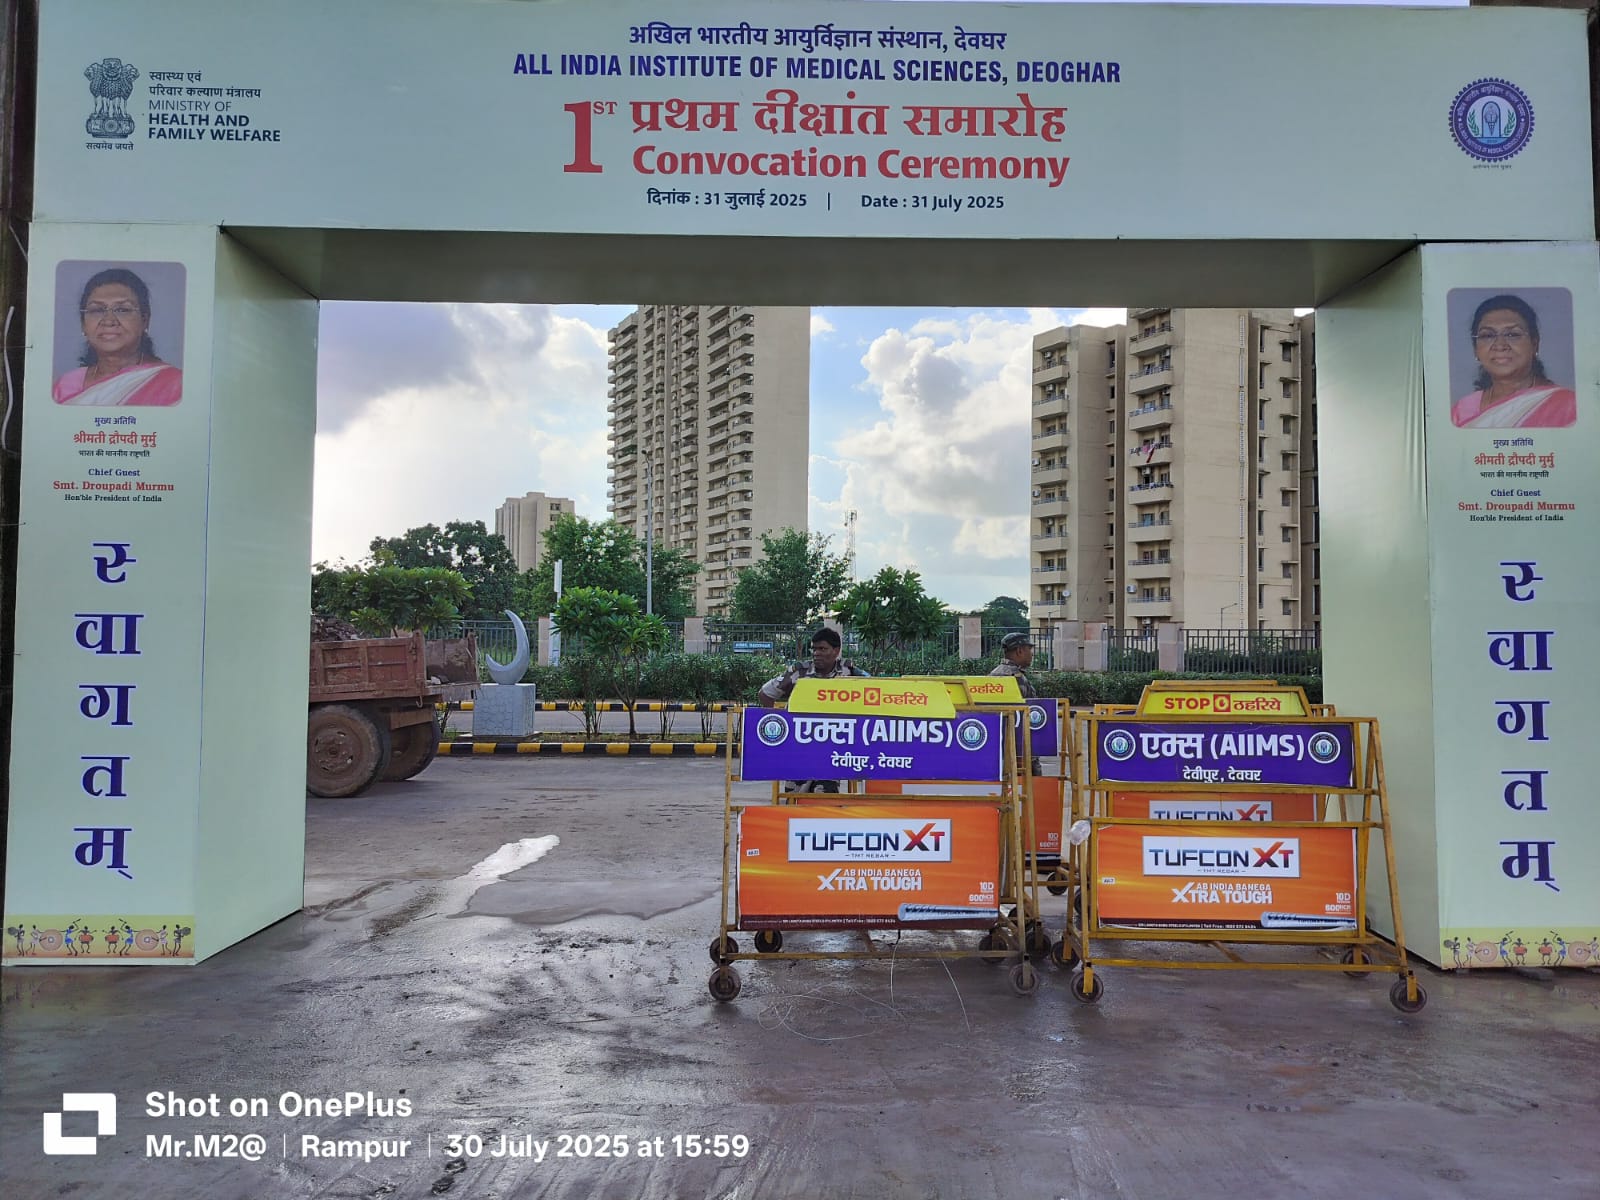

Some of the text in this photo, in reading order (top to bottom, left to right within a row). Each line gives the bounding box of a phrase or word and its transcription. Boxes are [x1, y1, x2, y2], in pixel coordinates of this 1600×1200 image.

[629, 21, 1007, 53] अखिल भारतीय आयुर्विज्ञान संस्थान, देवघर
[149, 70, 202, 83] स्वास्थ्य एवं
[513, 53, 1121, 86] ALL INDIA INSTITUTE OF MEDICAL SCIENCES, DEOGHAR
[149, 84, 261, 99] परिवार कल्याण मंत्रालय
[149, 100, 232, 112] MINISTRY OF
[149, 113, 250, 127] HEALTH AND
[629, 88, 1068, 143] प्रथम दीक्षांत समारोह
[149, 127, 281, 142] FAMILY WELFARE
[86, 142, 113, 150] सत्यमेव
[633, 145, 1070, 188] Convocation Ceremony
[647, 188, 691, 205] दिनांक
[704, 192, 720, 205] 31
[725, 189, 766, 210] जुलाई
[769, 193, 807, 207] 2025
[861, 195, 898, 208] Date
[911, 196, 927, 208] 31
[932, 195, 963, 212] July
[967, 196, 1005, 209] 2025
[74, 430, 106, 444] श्रीमती
[1474, 452, 1505, 465] श्रीमती
[88, 468, 140, 477] Chief Guest
[53, 480, 174, 492] Smt. Droupadi Murmu
[1490, 489, 1541, 497] Chief Guest
[64, 494, 92, 502] Hon'ble
[94, 494, 130, 502] President
[132, 494, 141, 502] of
[1458, 501, 1575, 512] Smt. Droupadi Murmu
[1470, 514, 1497, 522] Hon'ble
[969, 684, 1004, 695] ठहरिये
[817, 689, 929, 706] STOP ठहरिये
[1164, 698, 1281, 711] STOP ठहरिये
[793, 717, 856, 745] एम्स
[862, 719, 953, 748] (AIIMS)
[1139, 733, 1204, 760] एम्स
[1210, 733, 1304, 761] (AIIMS)
[831, 751, 913, 771] देवीपुर, देवघर
[1183, 766, 1262, 783] देवीपुर, देवघर
[817, 868, 922, 891] XTRA TOUGH
[844, 869, 921, 877] AB INDIA BANEGA
[1171, 882, 1272, 904] XTRA TOUGH
[1196, 883, 1271, 891] AB INDIA BANEGA
